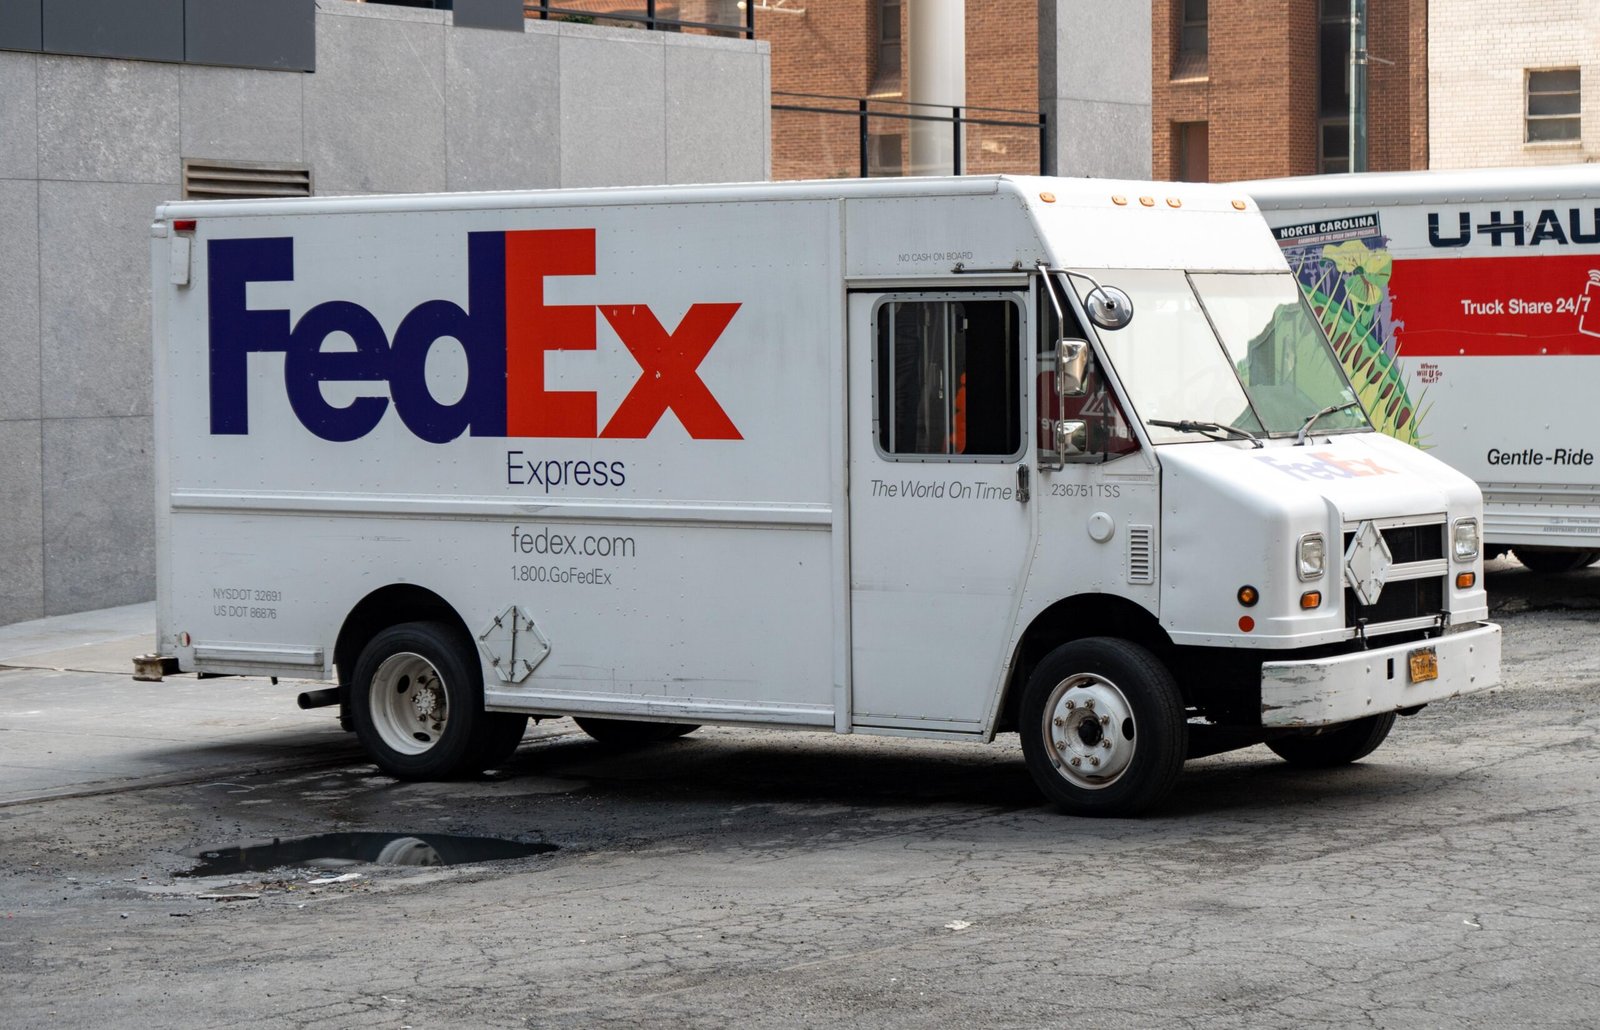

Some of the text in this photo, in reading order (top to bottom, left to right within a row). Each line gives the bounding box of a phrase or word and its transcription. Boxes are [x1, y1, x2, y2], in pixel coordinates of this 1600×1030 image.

[1280, 224, 1316, 238] NORTH
[1319, 216, 1375, 233] CAROLINA
[898, 251, 973, 262] NO CASH ON BOARD
[1461, 294, 1591, 316] Truck Share 24/7
[207, 228, 745, 444] FedEx
[1428, 370, 1434, 378] U
[1253, 452, 1400, 481] FedEx
[1487, 448, 1594, 466] Gentle-Ride
[507, 450, 626, 493] Express
[871, 479, 1012, 500] The World On Time
[1051, 483, 1121, 498] 236751 TSS
[511, 526, 636, 557] fedex.com
[511, 565, 612, 585] 1.800.GoFedEx
[213, 588, 282, 602] NYSDOT 32691
[213, 605, 227, 616] US
[228, 605, 248, 617] DOT
